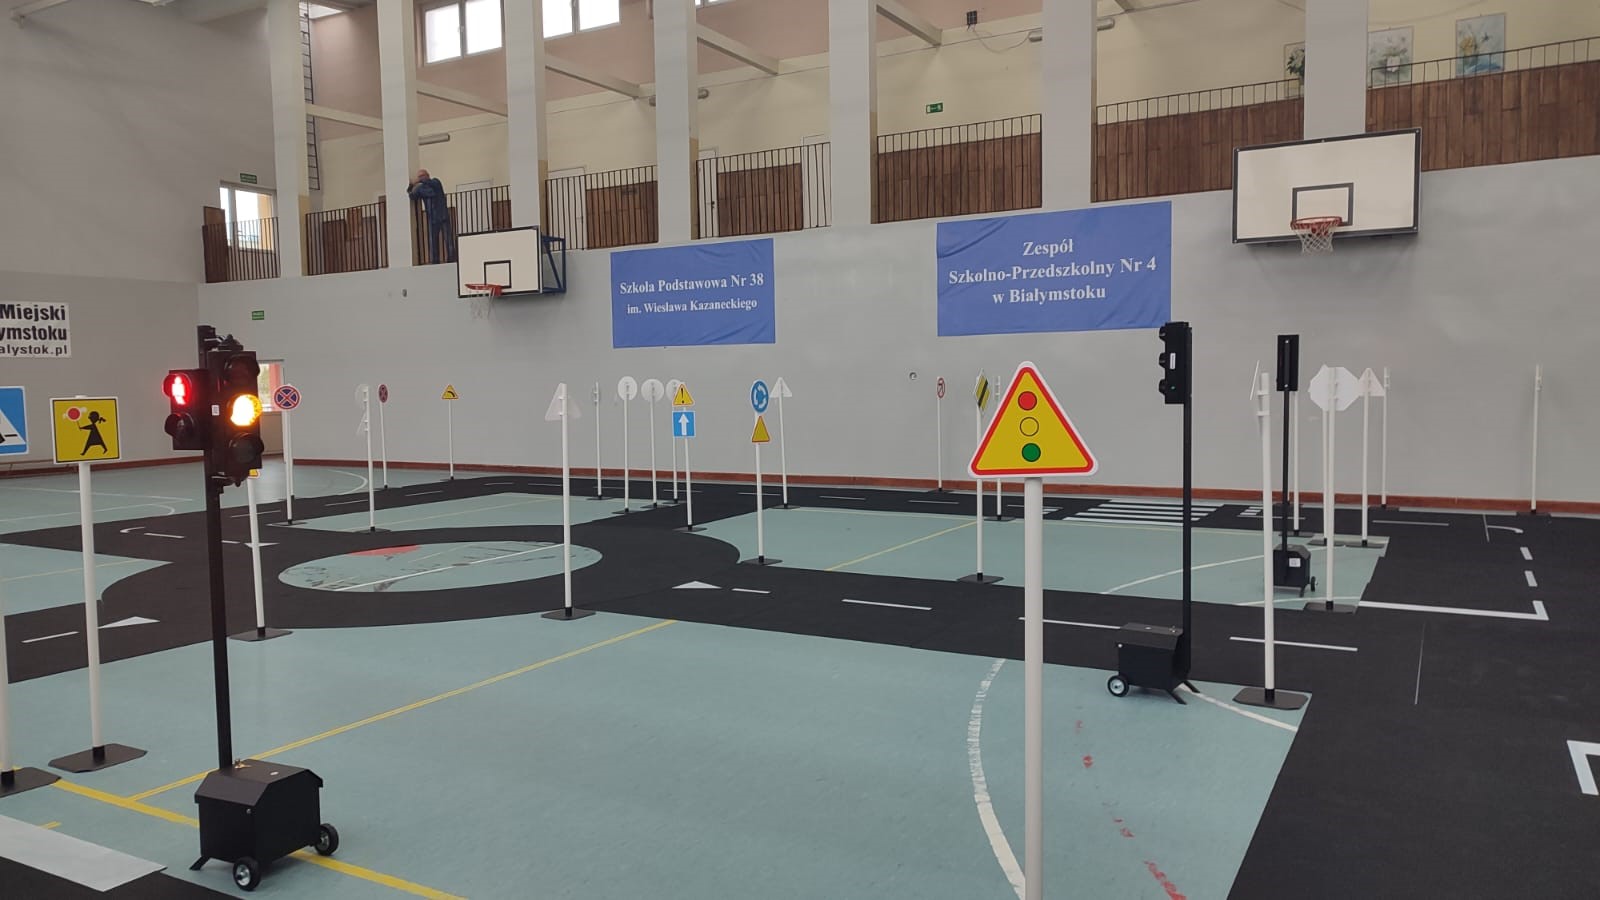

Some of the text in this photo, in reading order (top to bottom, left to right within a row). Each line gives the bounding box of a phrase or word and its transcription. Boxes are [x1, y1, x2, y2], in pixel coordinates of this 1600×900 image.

[949, 256, 1157, 285] Szkolno-Przedszkolny Nr 4
[658, 278, 727, 291] Podstawowa
[730, 274, 747, 287] Nr
[750, 272, 764, 286] 38
[627, 304, 641, 314] im.
[690, 297, 757, 311] Kazaneckiego
[992, 293, 1005, 304] w
[0, 303, 66, 322] Miejski
